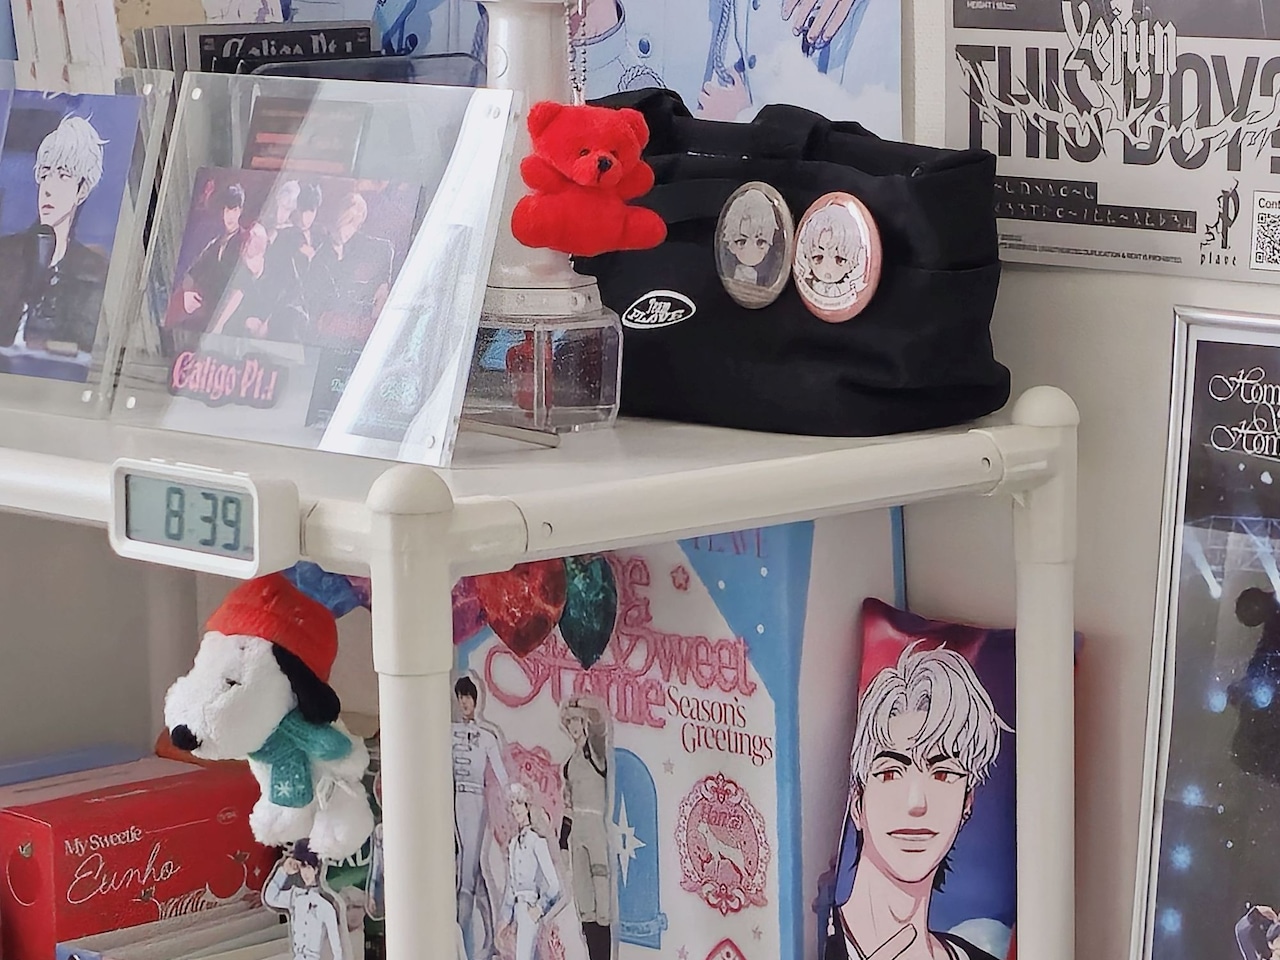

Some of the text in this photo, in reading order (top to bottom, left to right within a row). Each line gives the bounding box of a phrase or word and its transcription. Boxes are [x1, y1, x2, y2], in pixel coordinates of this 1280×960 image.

[667, 684, 748, 730] Season's
[681, 721, 774, 767] Greetings
[64, 836, 89, 858] My
[66, 841, 182, 905] Eunho
